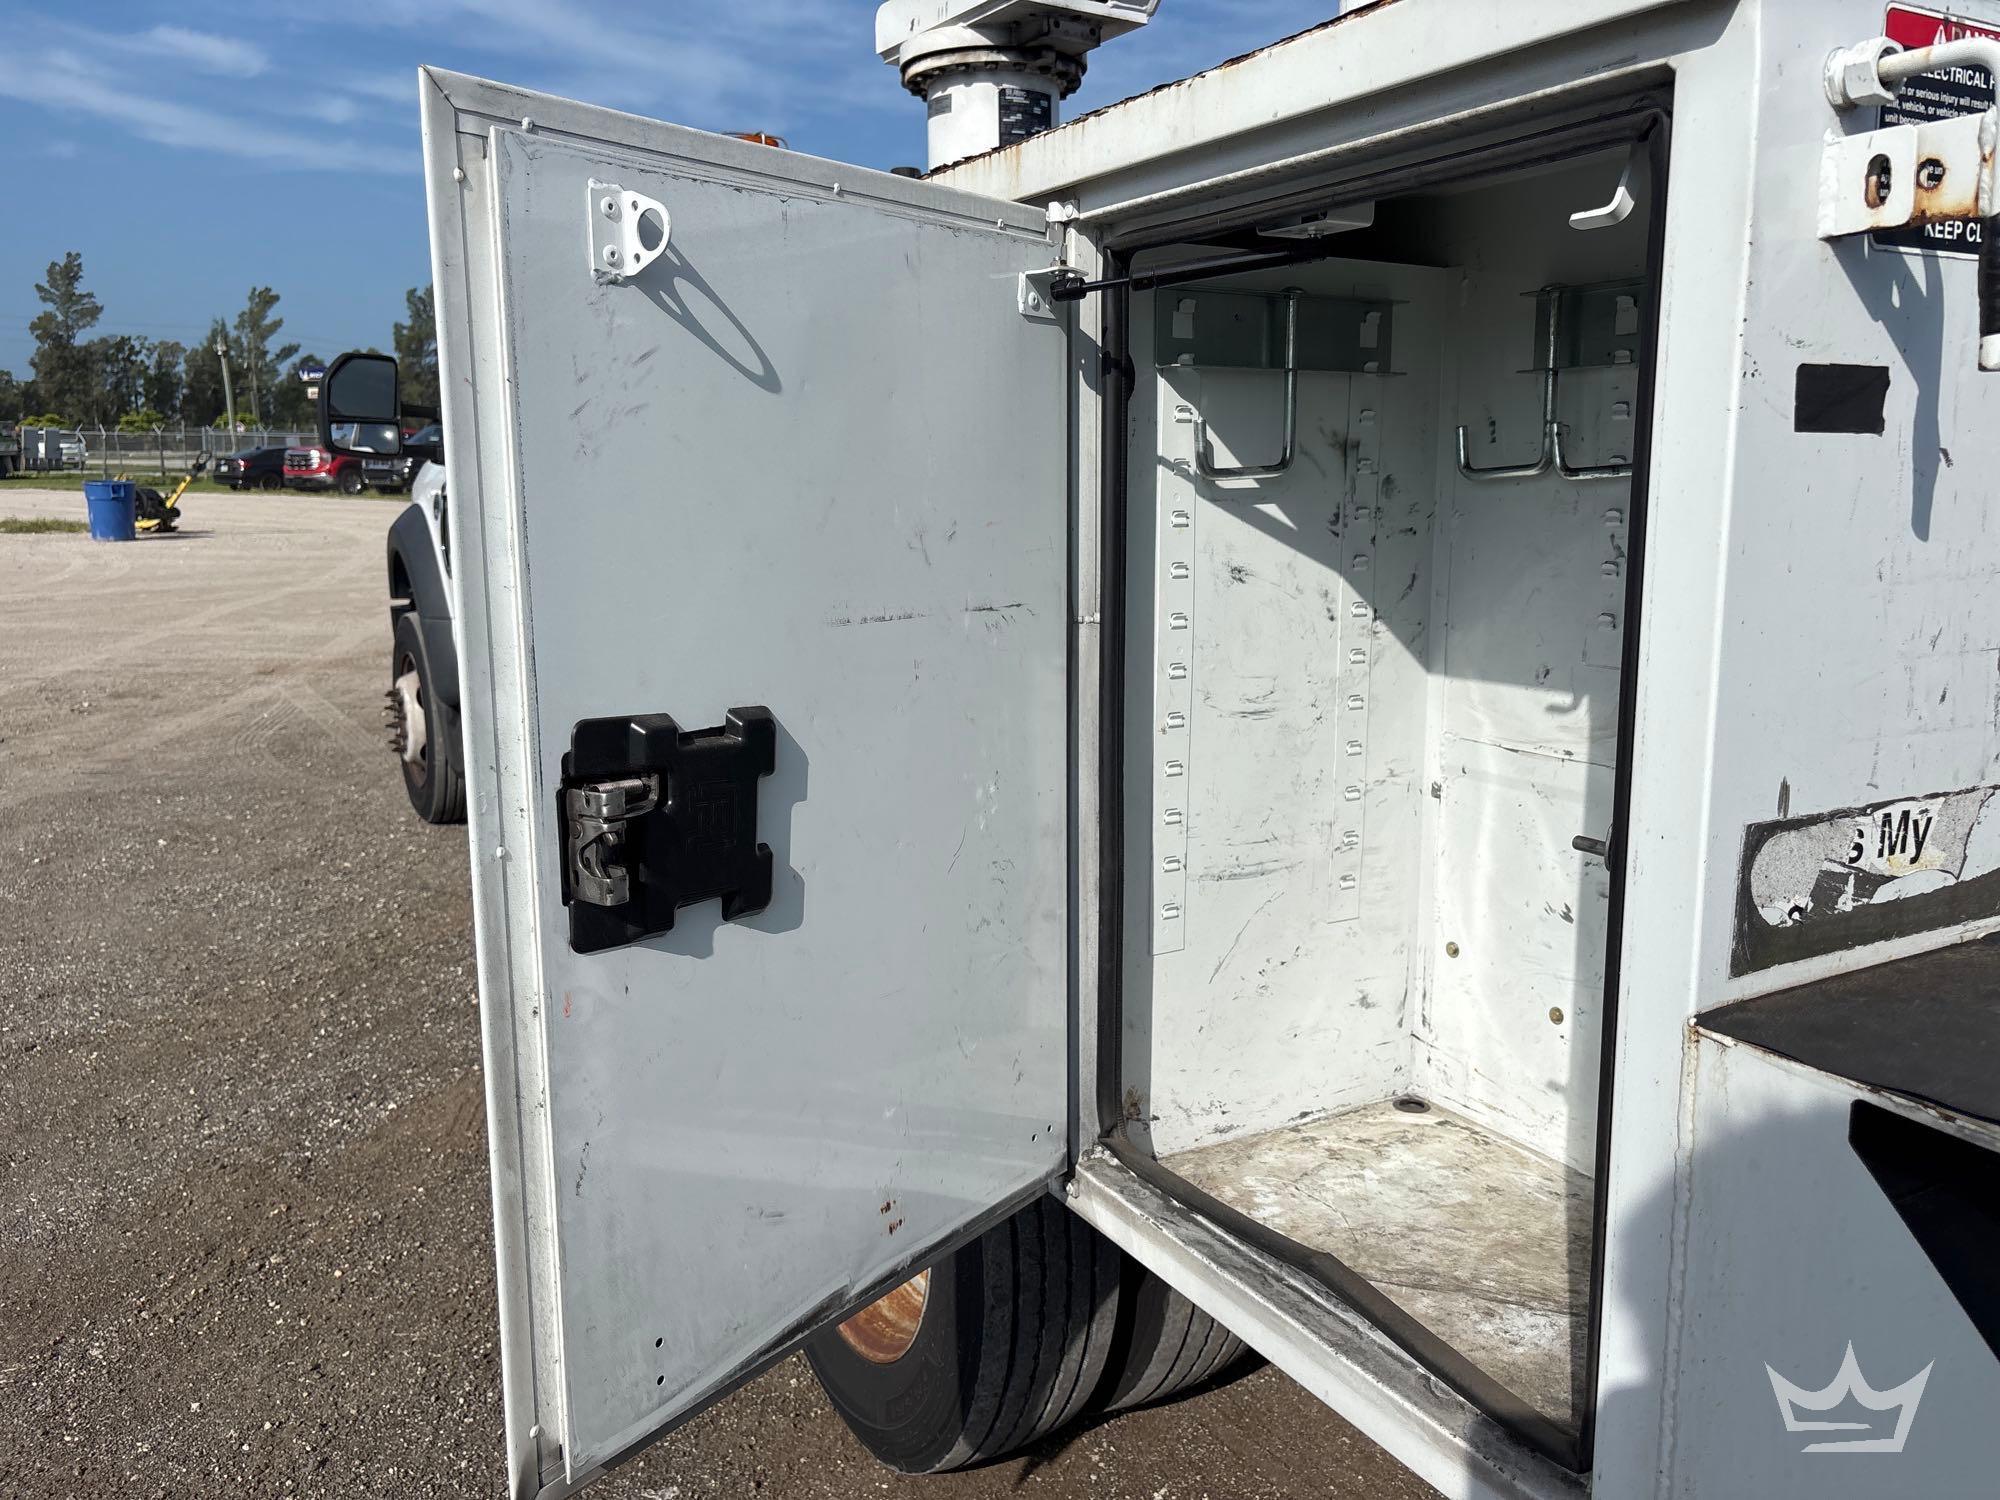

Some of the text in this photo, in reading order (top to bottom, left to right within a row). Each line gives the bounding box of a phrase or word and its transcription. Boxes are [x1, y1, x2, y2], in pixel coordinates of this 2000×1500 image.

[1921, 66, 1988, 89] ECTRICAL
[1907, 87, 1915, 96] or
[1916, 88, 1940, 101] serious
[1940, 91, 1959, 106] injury
[1959, 96, 1971, 107] will
[1971, 100, 1988, 109] result
[1885, 113, 1898, 123] unit
[1902, 100, 1926, 115] vehicle,
[1928, 105, 1935, 115] or
[1936, 107, 1958, 118] vehicle
[1924, 220, 1963, 240] KEEP
[1877, 809, 1933, 865] My
